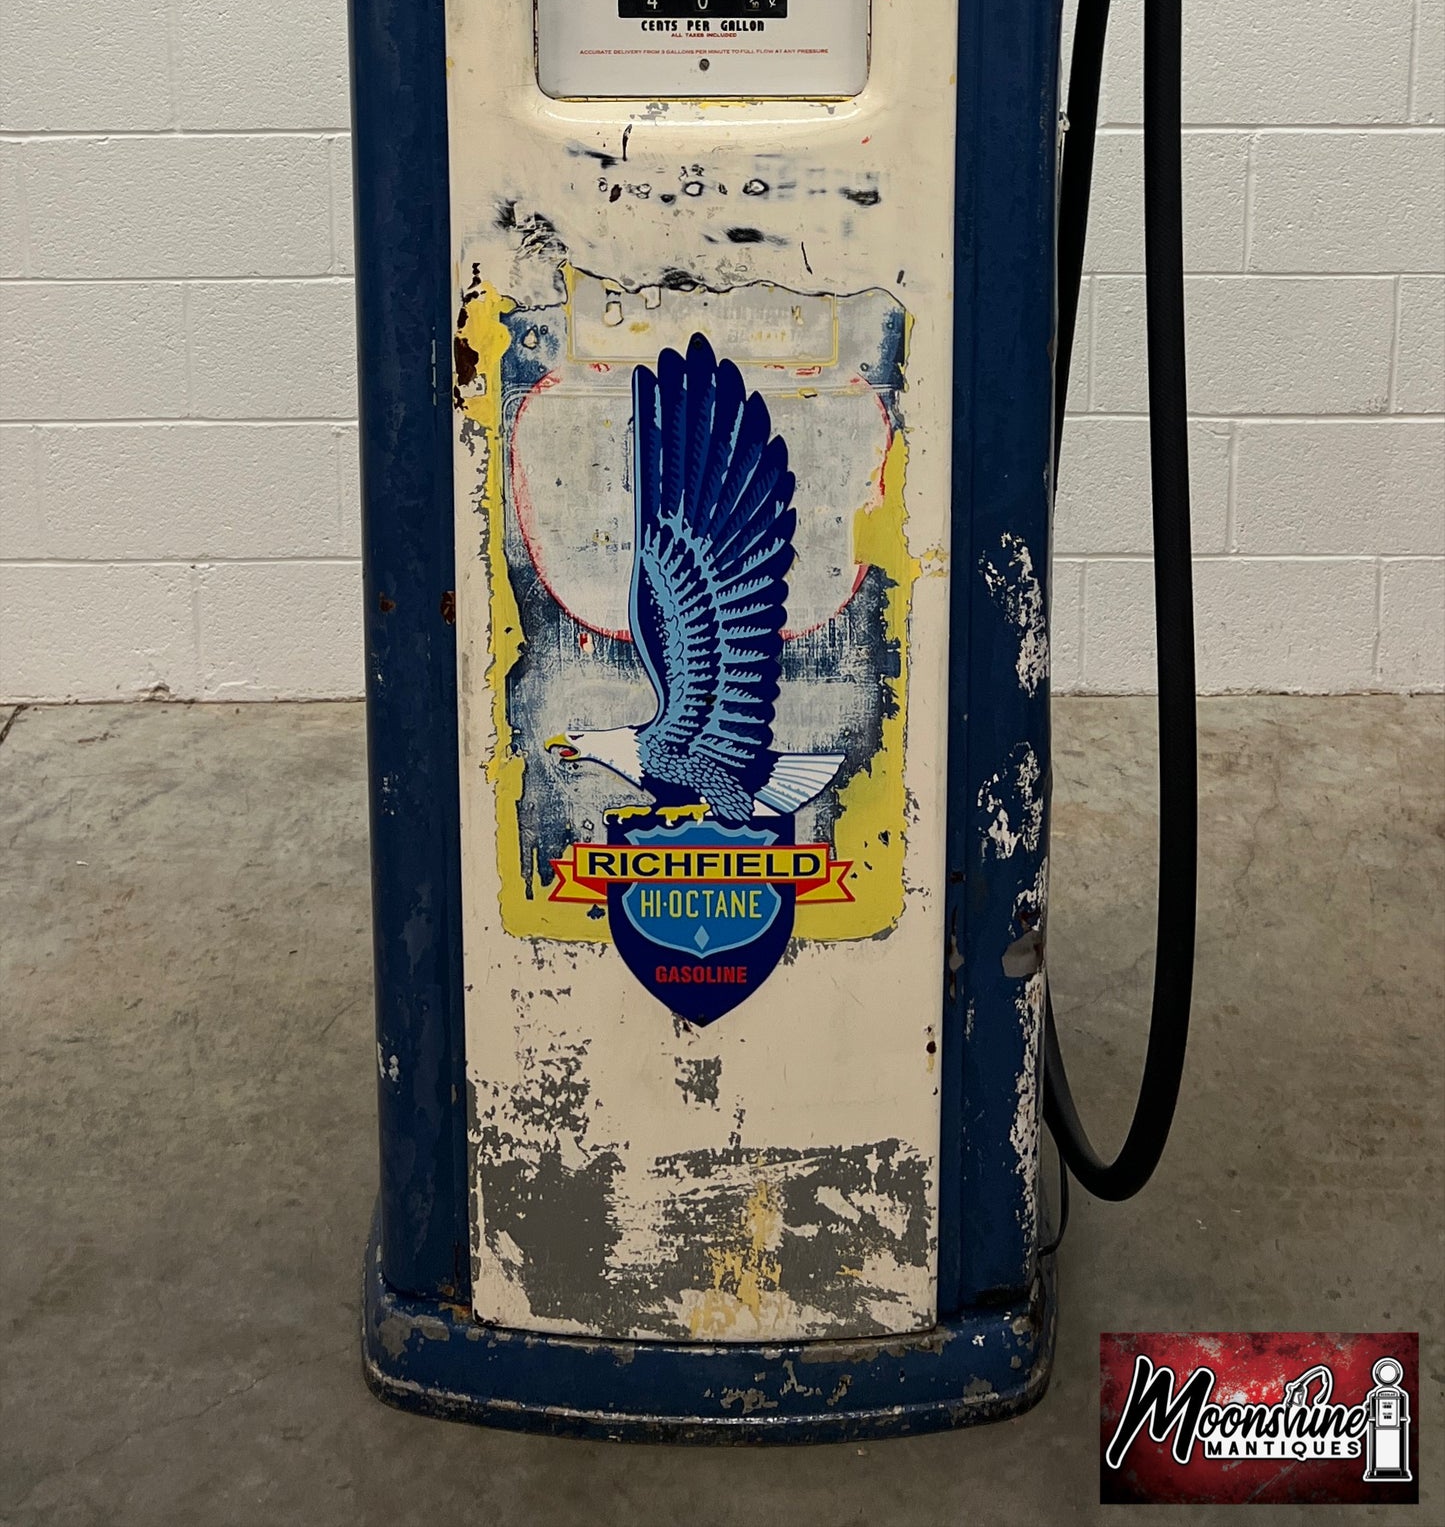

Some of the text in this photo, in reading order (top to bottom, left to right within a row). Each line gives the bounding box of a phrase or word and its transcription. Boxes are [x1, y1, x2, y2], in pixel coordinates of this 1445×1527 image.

[641, 20, 765, 32] CENTS PER GALLON
[588, 852, 821, 877] RICHFIELD
[655, 966, 748, 984] GASOLINE
